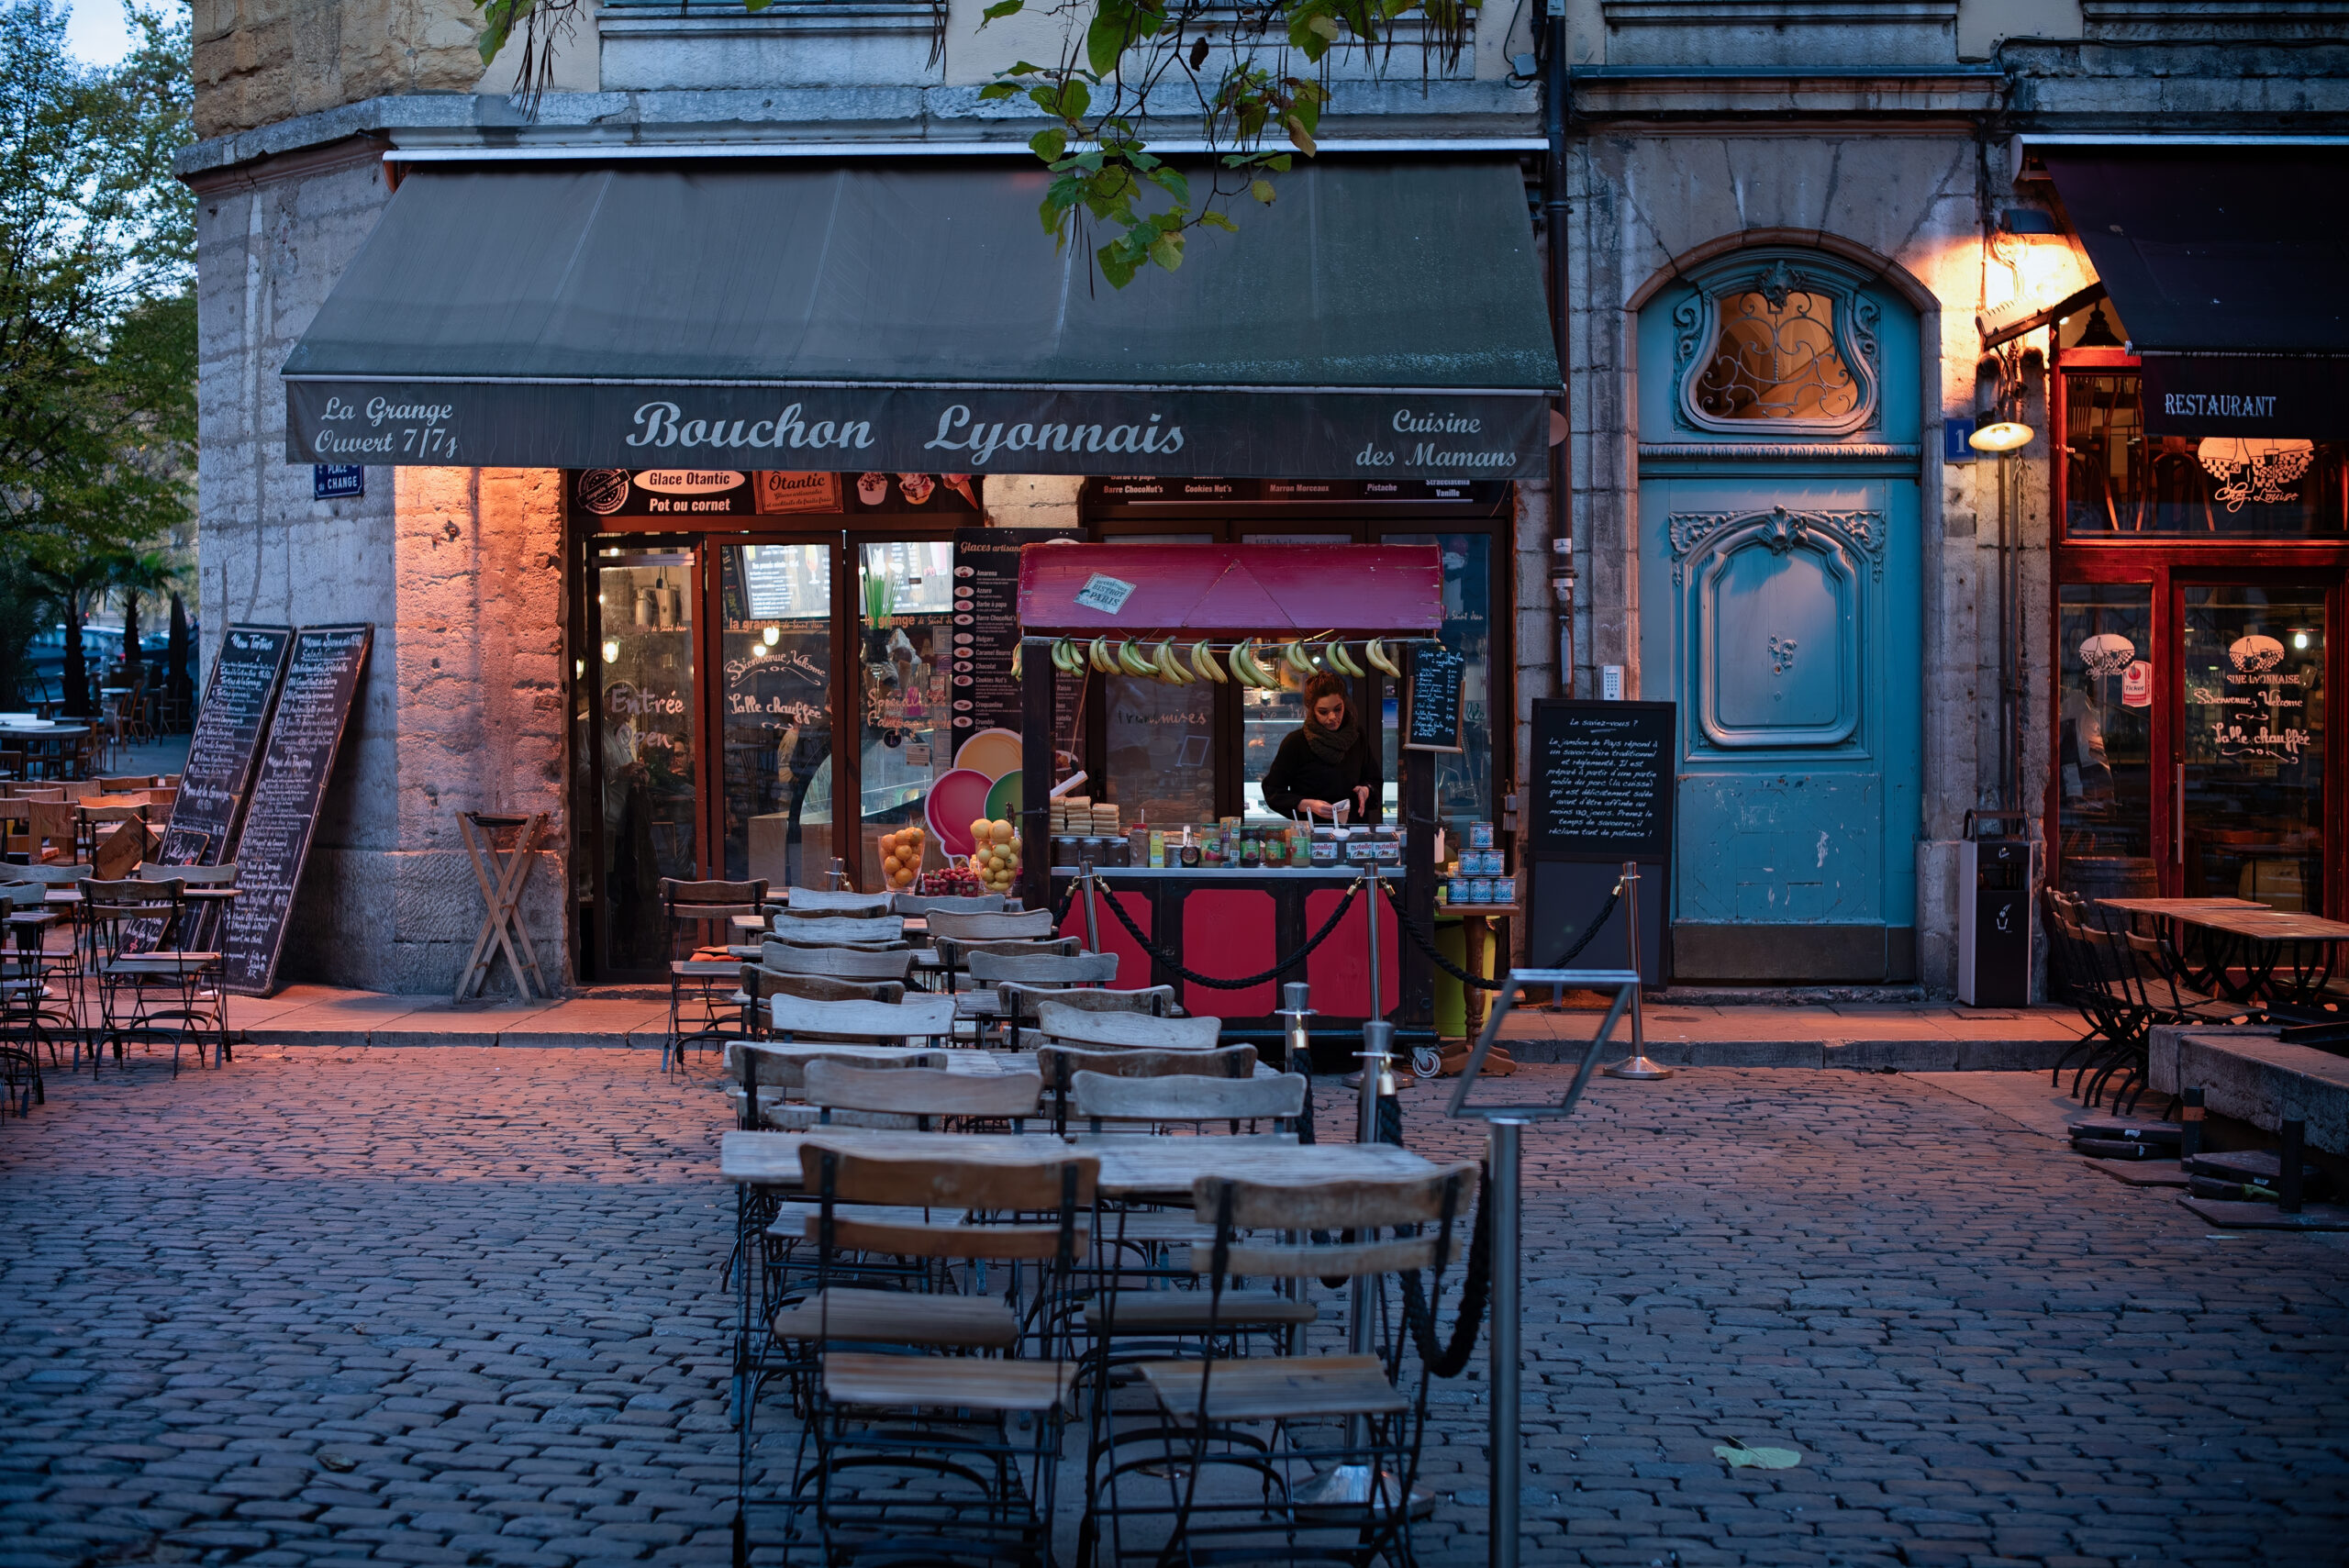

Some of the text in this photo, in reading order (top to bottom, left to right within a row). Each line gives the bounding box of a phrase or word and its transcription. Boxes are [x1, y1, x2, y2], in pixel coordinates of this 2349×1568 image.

[2165, 394, 2277, 417] RESTAURANT
[321, 396, 454, 428] La Grange
[1392, 409, 1482, 434] Cuisine
[625, 401, 1186, 466] Bouchon Lyonnais
[315, 429, 394, 453] Ouvert
[1956, 428, 1966, 453] 1
[1355, 442, 1517, 467] des Mamans
[327, 475, 358, 490] CHANGE
[649, 472, 730, 485] Glace Otantic
[769, 471, 826, 491] Ôtantic
[1103, 484, 1163, 494] Barre ChocoNut's
[1185, 484, 1232, 493] Cookies Nut's
[1270, 484, 1330, 493] Marron Morceaux
[1367, 484, 1397, 493] Pistache
[1436, 489, 1461, 497] Vanille
[2253, 488, 2299, 503] Louise
[649, 498, 730, 512] Pot ou cornet
[961, 542, 1020, 553] Glaces artisan
[1089, 591, 1119, 606] PARIS
[729, 617, 739, 629] la
[878, 616, 915, 628] grange
[2249, 674, 2300, 684] LYONNAISE
[611, 687, 685, 715] Entrée
[766, 696, 822, 725] chauffée
[1582, 719, 1630, 728] saviez-vous
[616, 724, 673, 754] Open
[1549, 737, 1558, 745] Le
[1558, 738, 1589, 748] jambon
[1603, 740, 1621, 749] Pays
[1624, 739, 1651, 749] répond
[2212, 722, 2311, 754] Salle chauffée
[1563, 748, 1609, 756] savoir-faire
[1611, 750, 1656, 758] traditionnel
[1546, 768, 1576, 777] préparé
[1585, 770, 1608, 779] partir
[1610, 768, 1632, 777] d'une
[1632, 771, 1657, 779] partie
[1586, 780, 1607, 789] porc
[1622, 780, 1653, 788] cuisse)
[1549, 789, 1563, 798] qui
[1581, 789, 1631, 797] délicatement
[1632, 790, 1653, 798] salée
[1579, 796, 1602, 806] d'être
[1604, 798, 1633, 806] affinée
[1558, 818, 1584, 827] temps
[1610, 829, 1645, 839] patience
